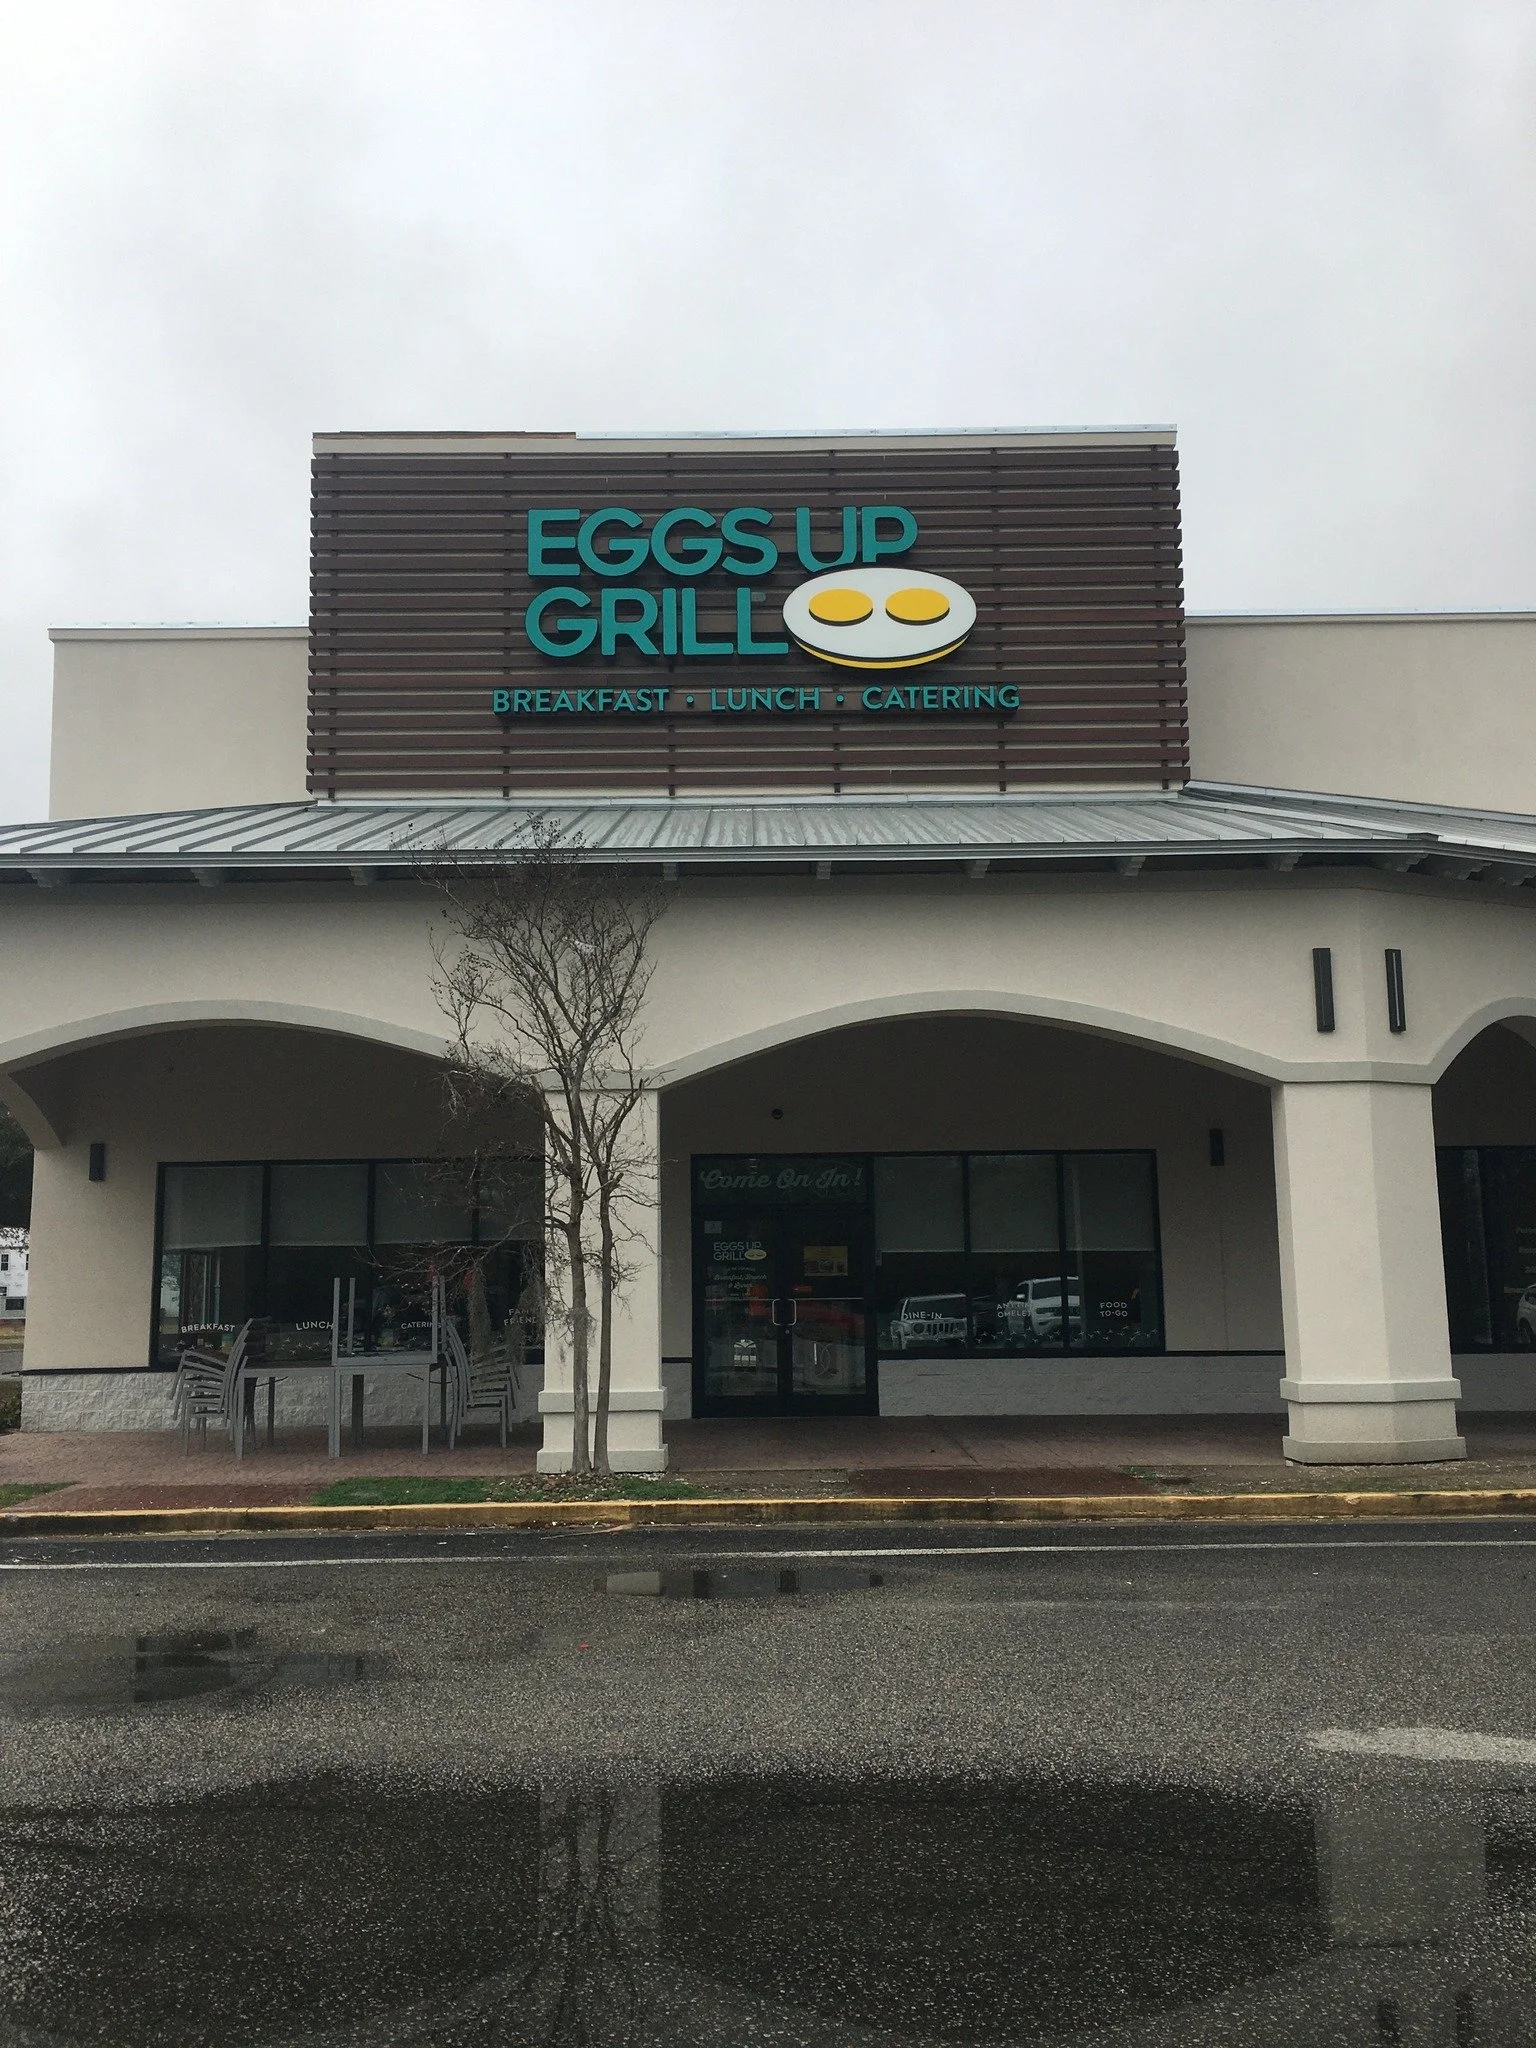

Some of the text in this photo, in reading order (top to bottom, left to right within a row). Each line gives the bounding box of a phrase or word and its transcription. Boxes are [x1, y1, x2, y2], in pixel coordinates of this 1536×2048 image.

[527, 505, 919, 578] EGGS UP
[524, 586, 790, 659] GRILL
[492, 684, 1021, 716] BREAKFAST LUNCH CATERING
[700, 1168, 772, 1190] Come
[776, 1168, 813, 1190] On
[713, 1241, 762, 1251] EGGS UP
[713, 1251, 746, 1261] GRILL
[1099, 1301, 1128, 1309] FOOD
[902, 1310, 943, 1321] DINE-IN
[1099, 1309, 1129, 1318] TO-GO
[181, 1323, 236, 1334] BREAKFAST
[295, 1320, 335, 1331] LUNCH
